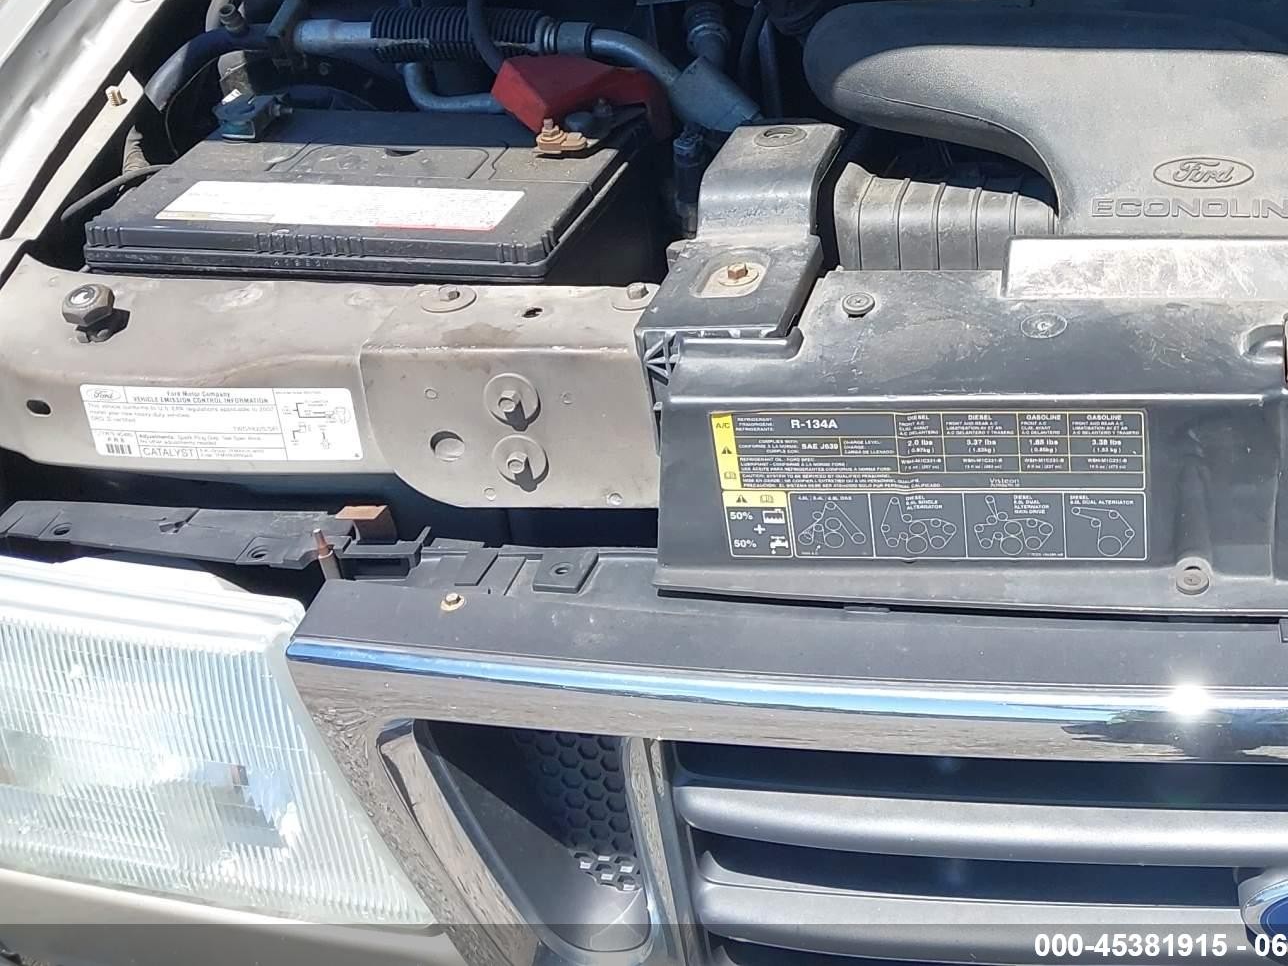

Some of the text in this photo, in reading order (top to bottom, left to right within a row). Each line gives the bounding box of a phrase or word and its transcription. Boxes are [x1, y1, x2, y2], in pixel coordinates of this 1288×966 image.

[1172, 160, 1234, 184] Ford
[790, 419, 838, 429] R-134A
[142, 447, 194, 457] CATALYST
[729, 511, 753, 520] 50%
[733, 539, 757, 548] 50%
